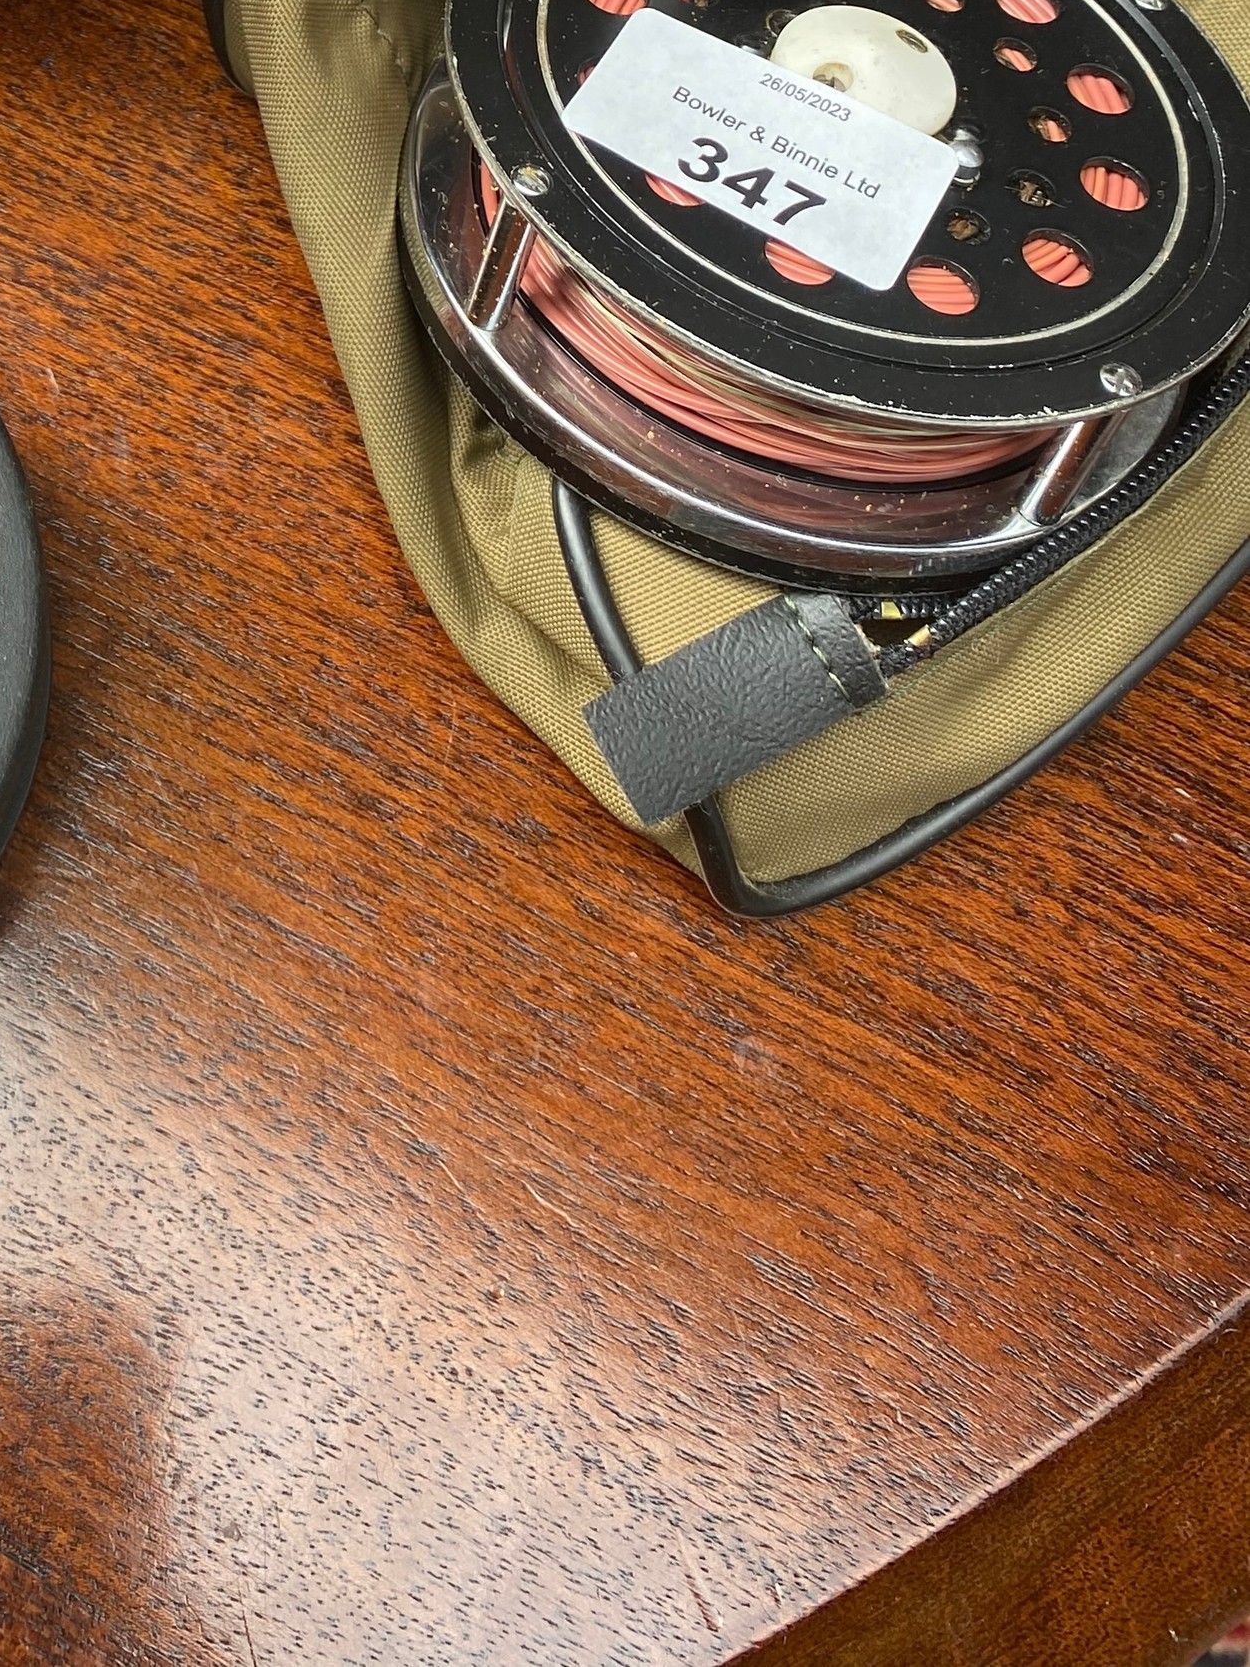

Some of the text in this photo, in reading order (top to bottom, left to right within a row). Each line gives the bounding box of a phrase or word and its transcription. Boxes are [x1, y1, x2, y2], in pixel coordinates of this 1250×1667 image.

[672, 85, 881, 200] Bowler & Binnie Ltd
[758, 72, 852, 123] 26/05/2023
[677, 137, 827, 227] 347
